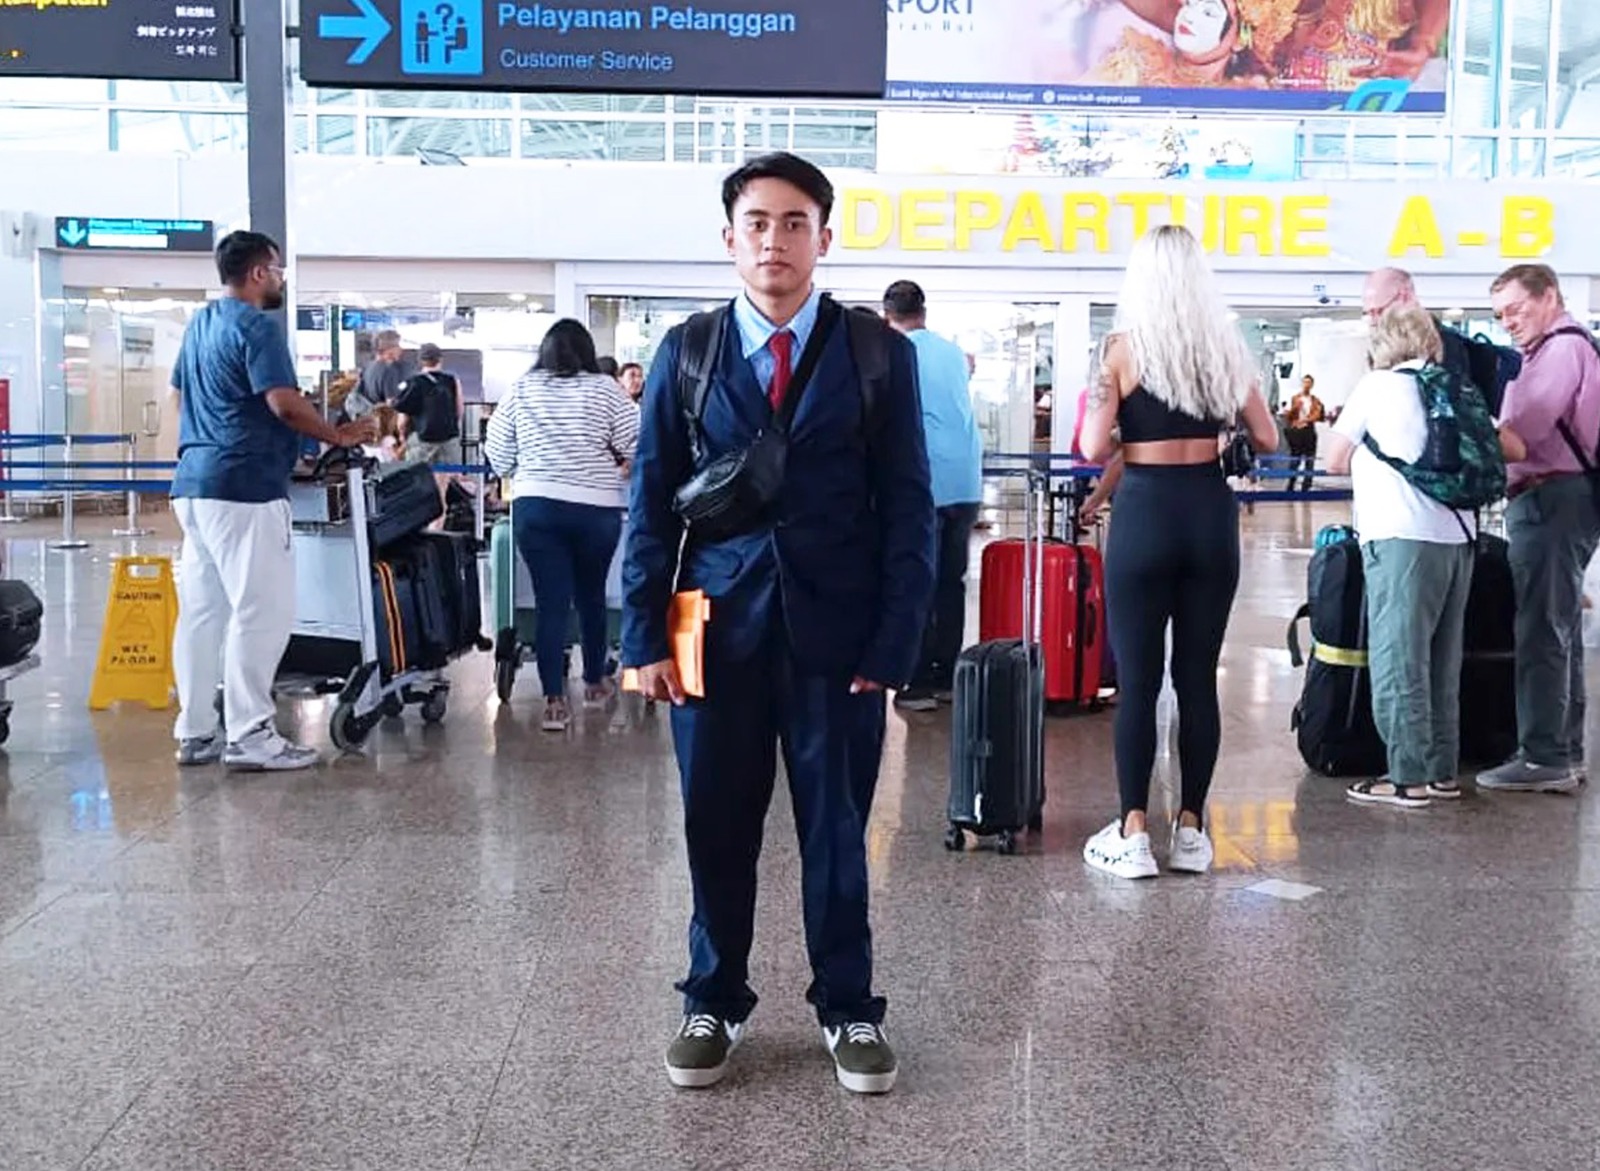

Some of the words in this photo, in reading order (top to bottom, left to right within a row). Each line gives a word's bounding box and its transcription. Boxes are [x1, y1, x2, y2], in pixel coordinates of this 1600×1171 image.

[498, 3, 642, 33] Pelayanan
[651, 6, 796, 38] Pelanggan
[500, 48, 595, 69] Customer
[600, 50, 675, 71] Service
[840, 188, 1330, 257] DEPARTURE
